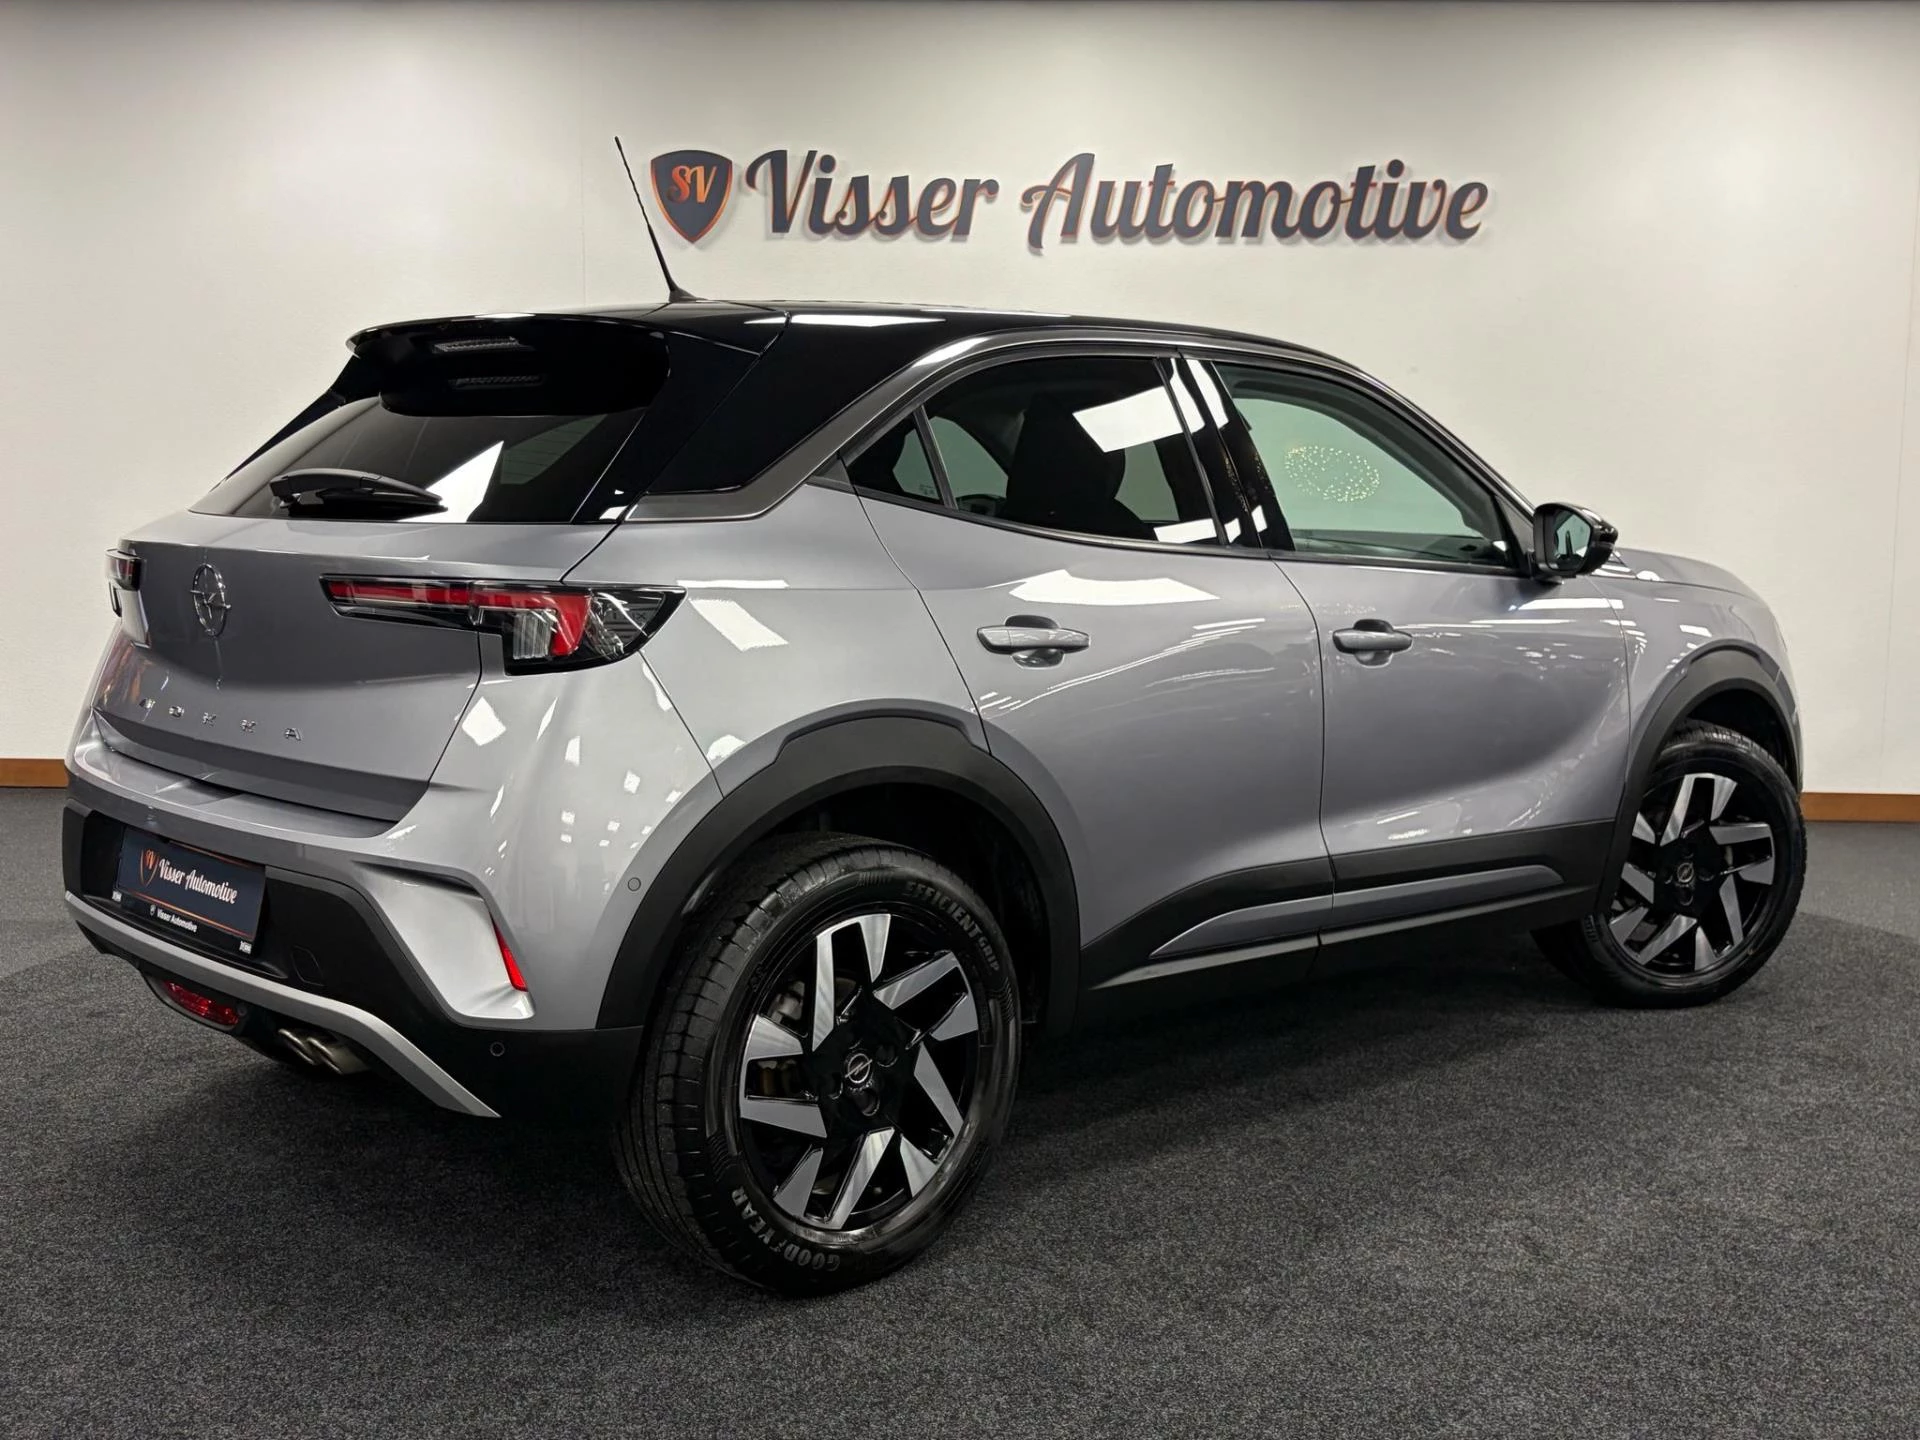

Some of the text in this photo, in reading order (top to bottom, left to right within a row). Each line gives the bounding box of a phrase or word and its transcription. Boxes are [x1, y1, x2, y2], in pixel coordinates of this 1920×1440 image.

[666, 164, 718, 205] SV
[745, 149, 1490, 250] Visser Automotive
[159, 858, 238, 905] Visser Automotive
[157, 908, 198, 933] Visser Automotive
